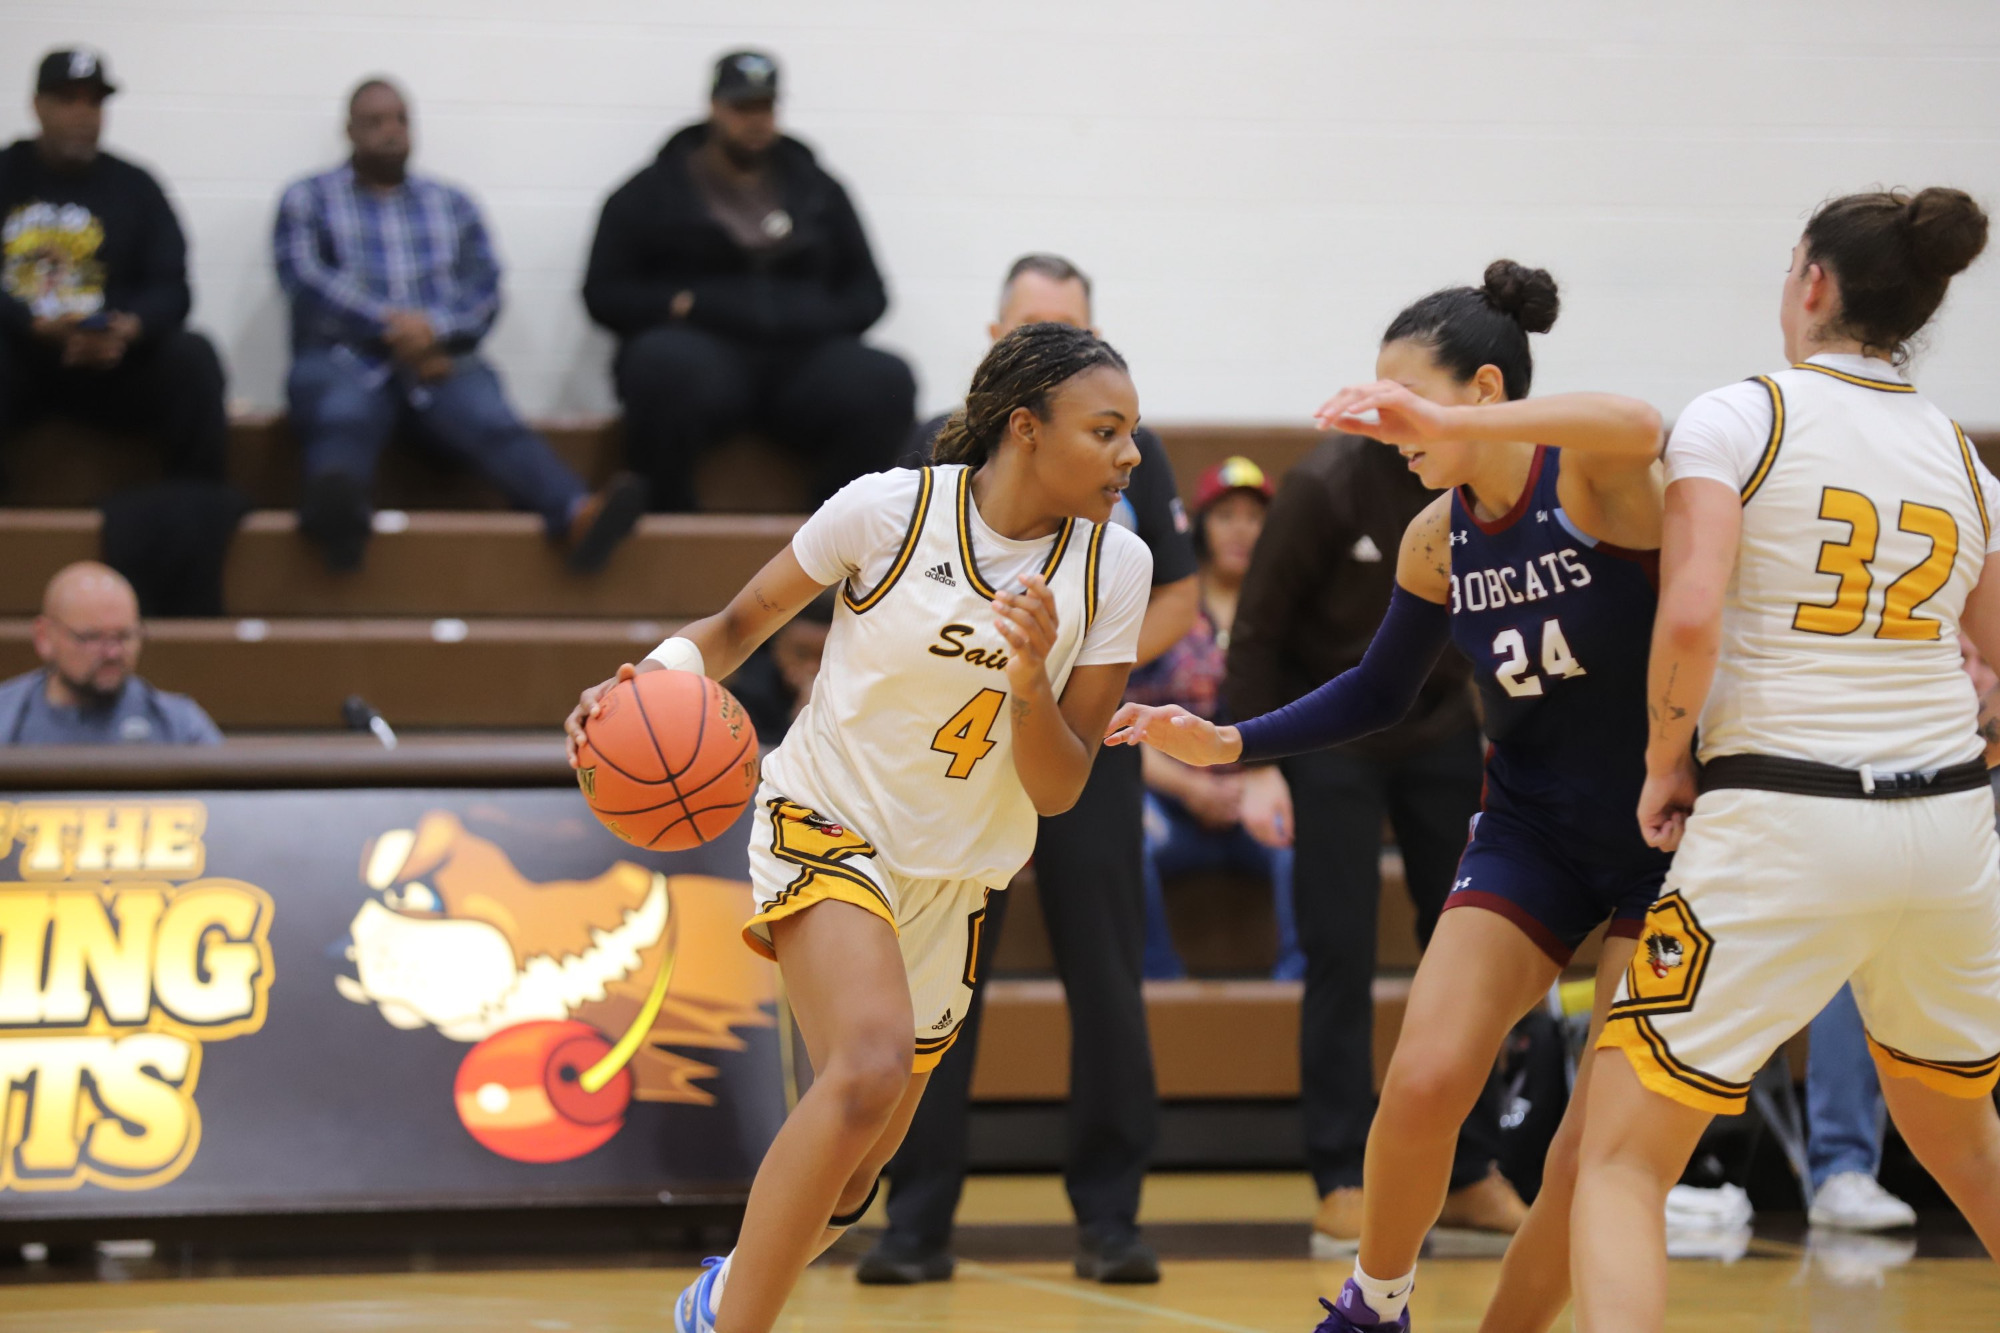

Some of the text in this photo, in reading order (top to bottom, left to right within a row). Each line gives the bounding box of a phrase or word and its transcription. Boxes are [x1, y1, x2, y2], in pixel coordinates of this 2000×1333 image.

[924, 570, 956, 588] adidas
[1791, 486, 1958, 641] 32
[1492, 618, 1588, 698] 24
[930, 687, 1007, 780] 4
[20, 803, 203, 876] THE
